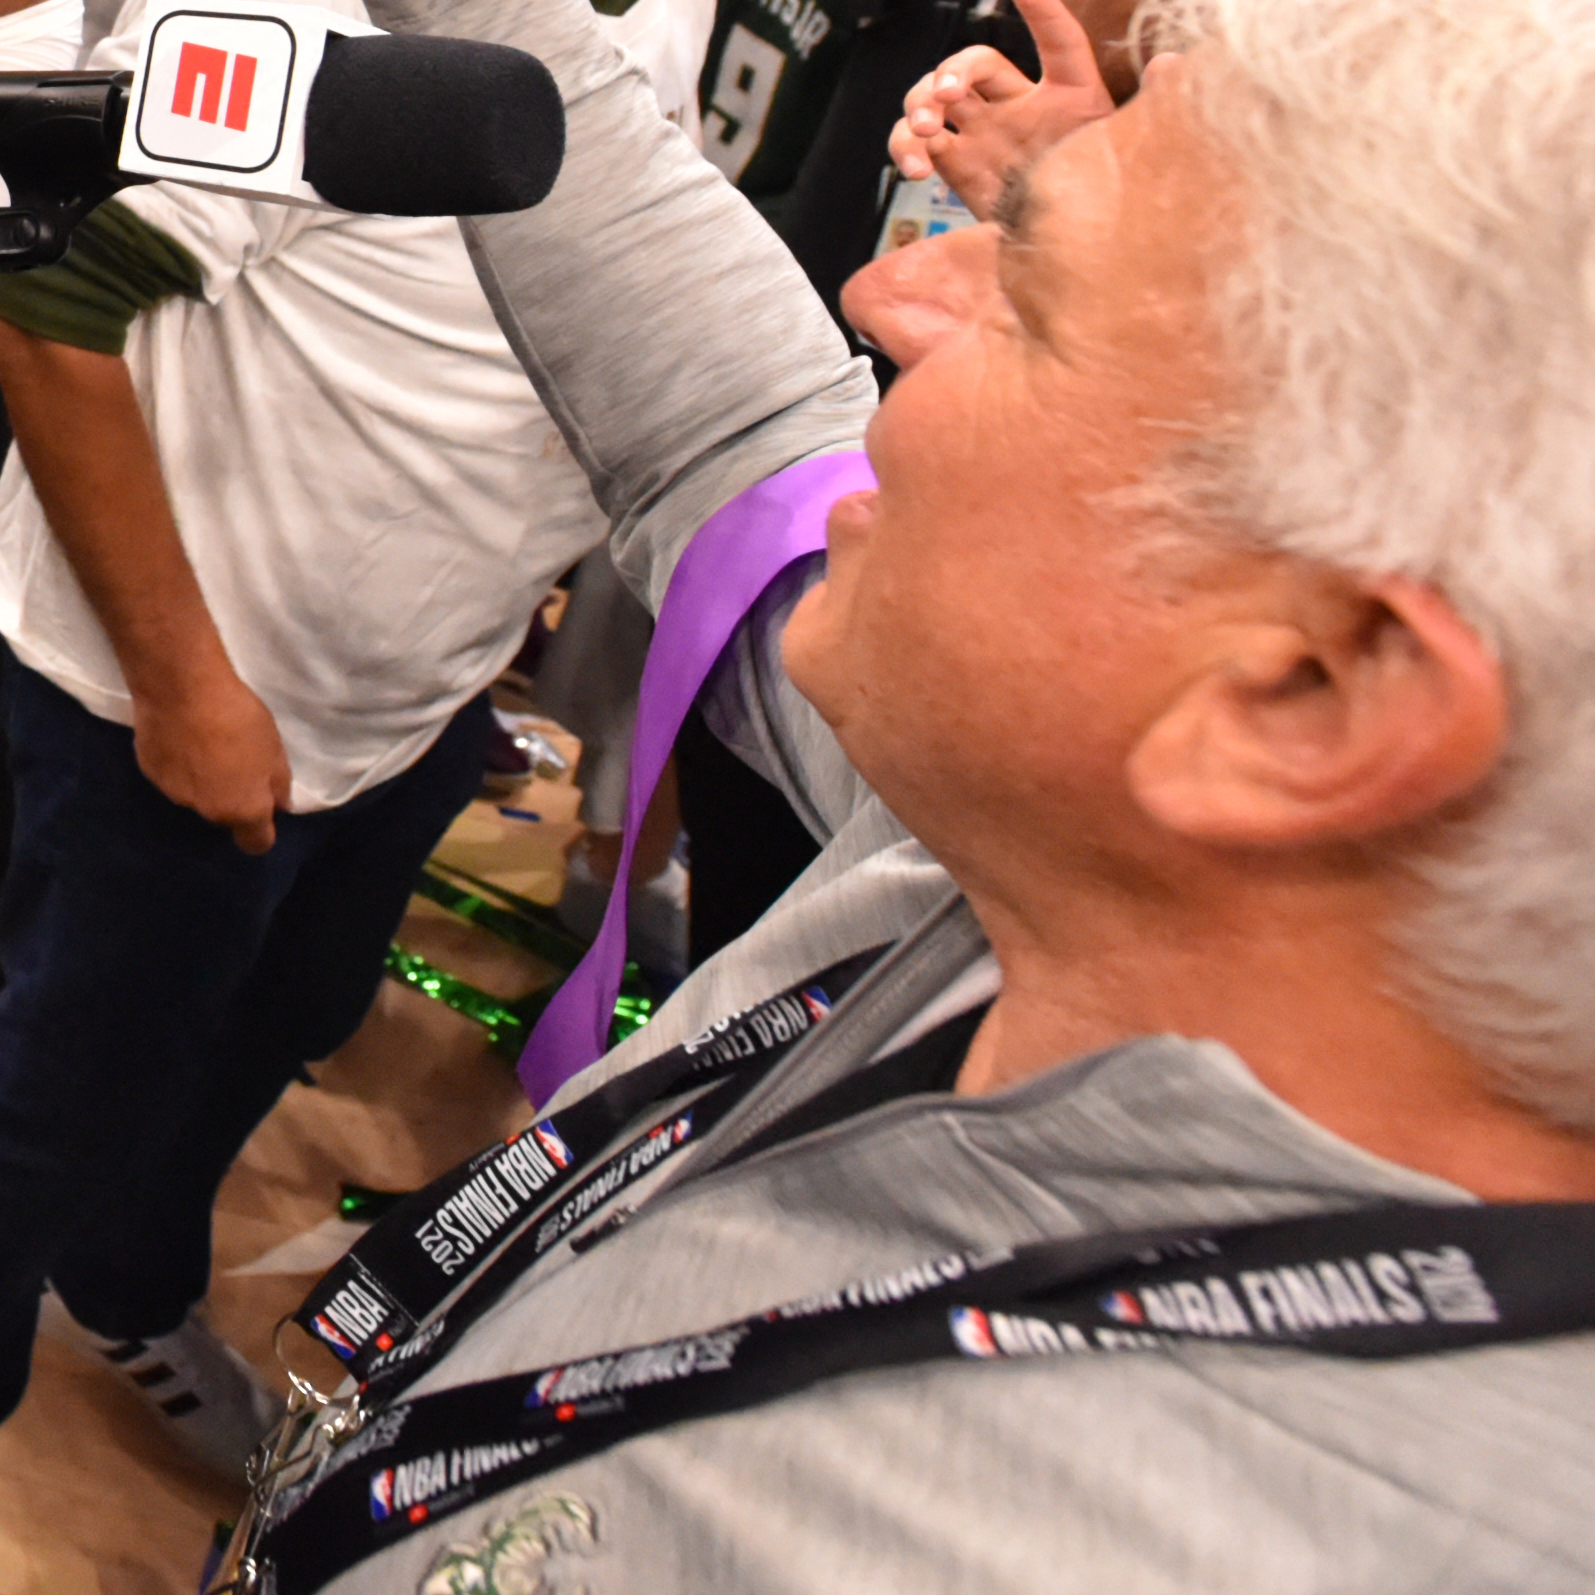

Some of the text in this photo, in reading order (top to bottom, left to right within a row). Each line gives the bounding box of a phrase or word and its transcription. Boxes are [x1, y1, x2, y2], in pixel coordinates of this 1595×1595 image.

[494, 1132, 558, 1201] NBA
[435, 1166, 519, 1256] FINALS
[414, 1219, 467, 1276] 2021
[324, 1279, 390, 1346] NBA
[1238, 1251, 1427, 1335] FINALS
